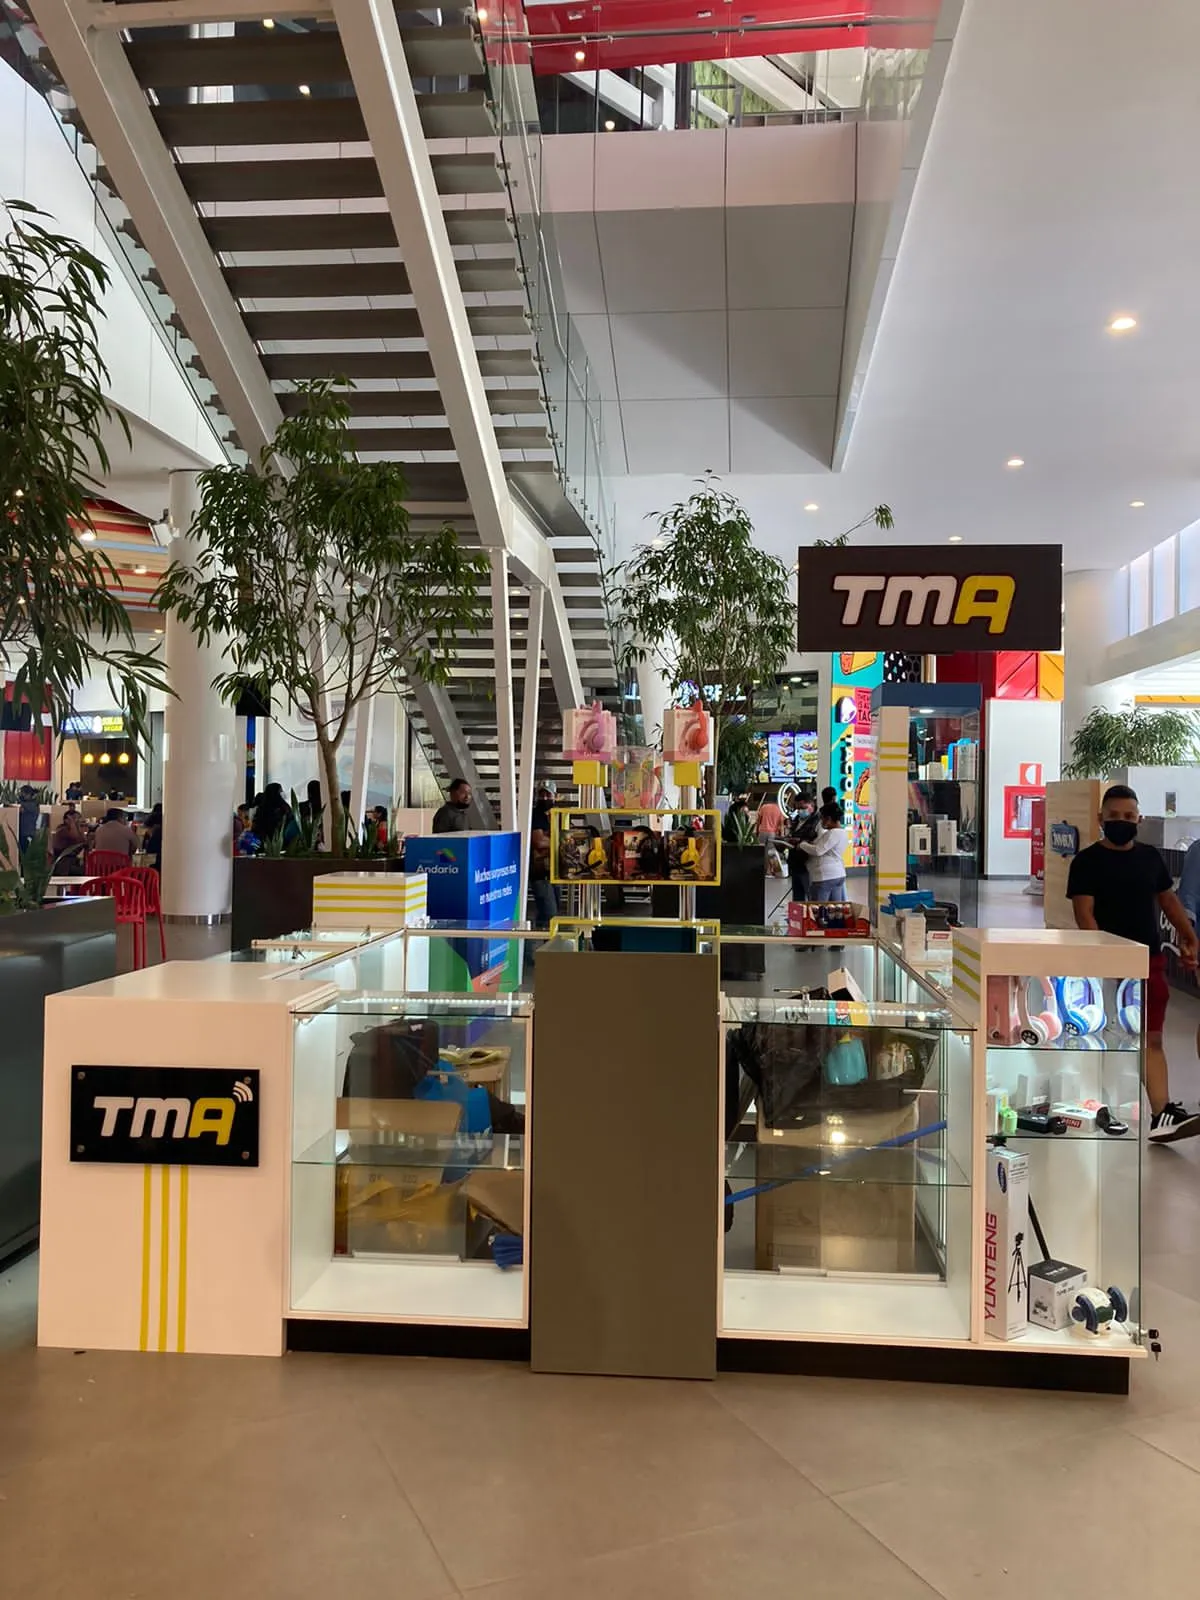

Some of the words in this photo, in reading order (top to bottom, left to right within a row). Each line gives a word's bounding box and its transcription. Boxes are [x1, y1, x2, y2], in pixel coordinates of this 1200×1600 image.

[833, 575, 1016, 634] TMA
[702, 684, 747, 702] BEL
[844, 734, 854, 793] TACO
[93, 1096, 236, 1146] TMA
[984, 1211, 998, 1320] YUNTENG
